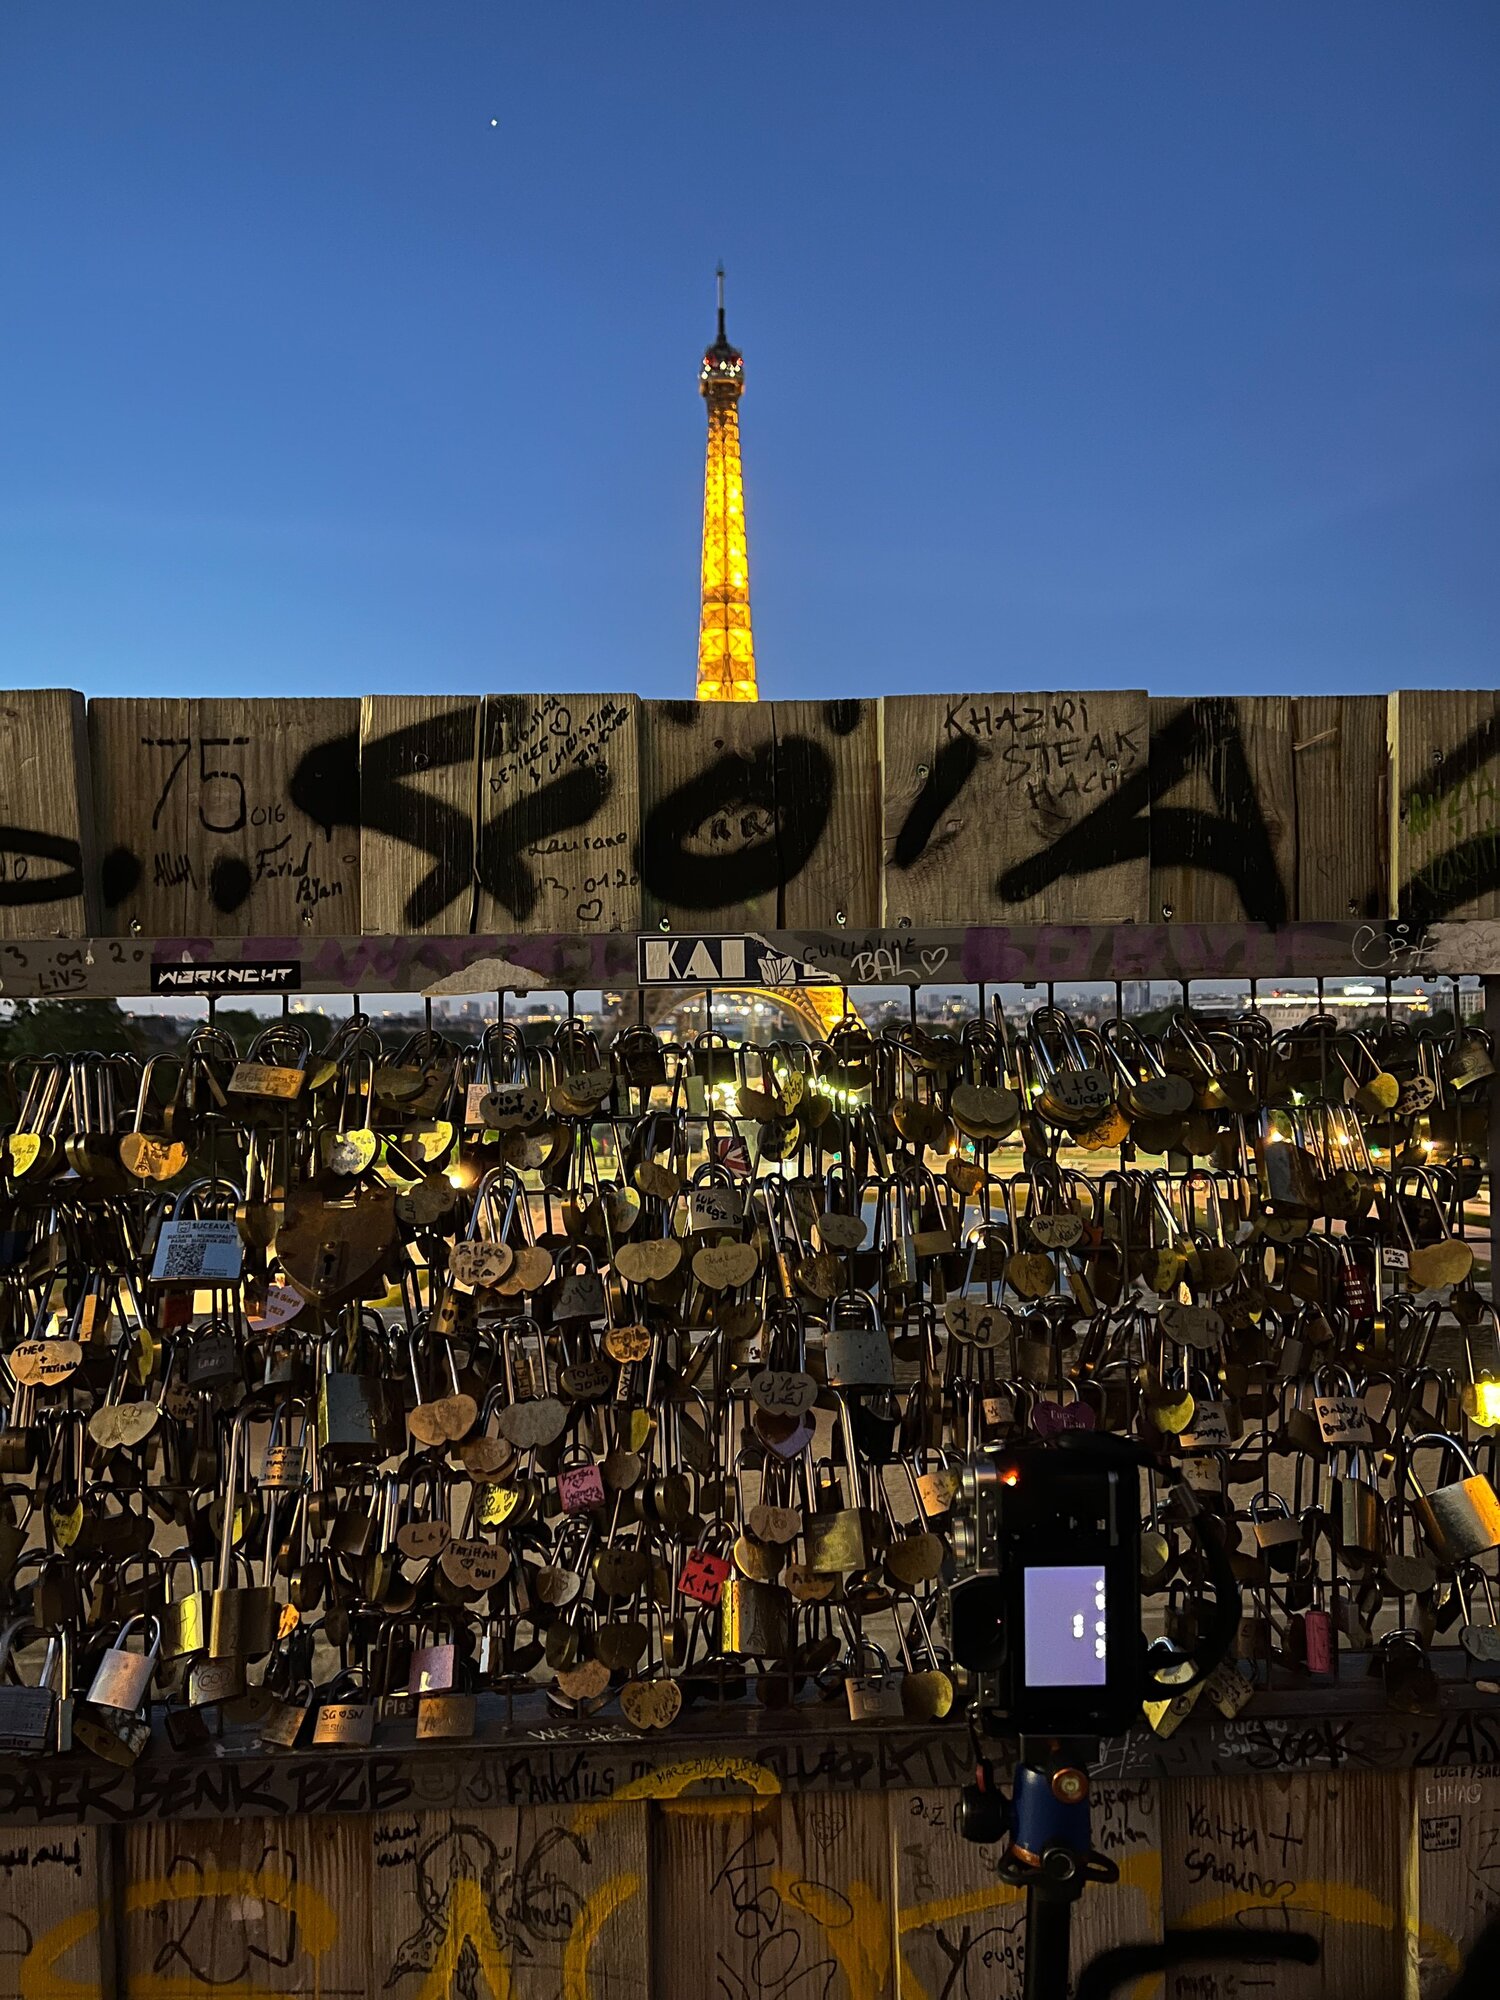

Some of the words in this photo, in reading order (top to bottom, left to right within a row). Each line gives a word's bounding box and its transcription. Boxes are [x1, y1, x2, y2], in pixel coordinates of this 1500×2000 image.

[141, 736, 250, 834] 75
[191, 1222, 231, 1230] SUCEAVA
[14, 1344, 46, 1357] THEO
